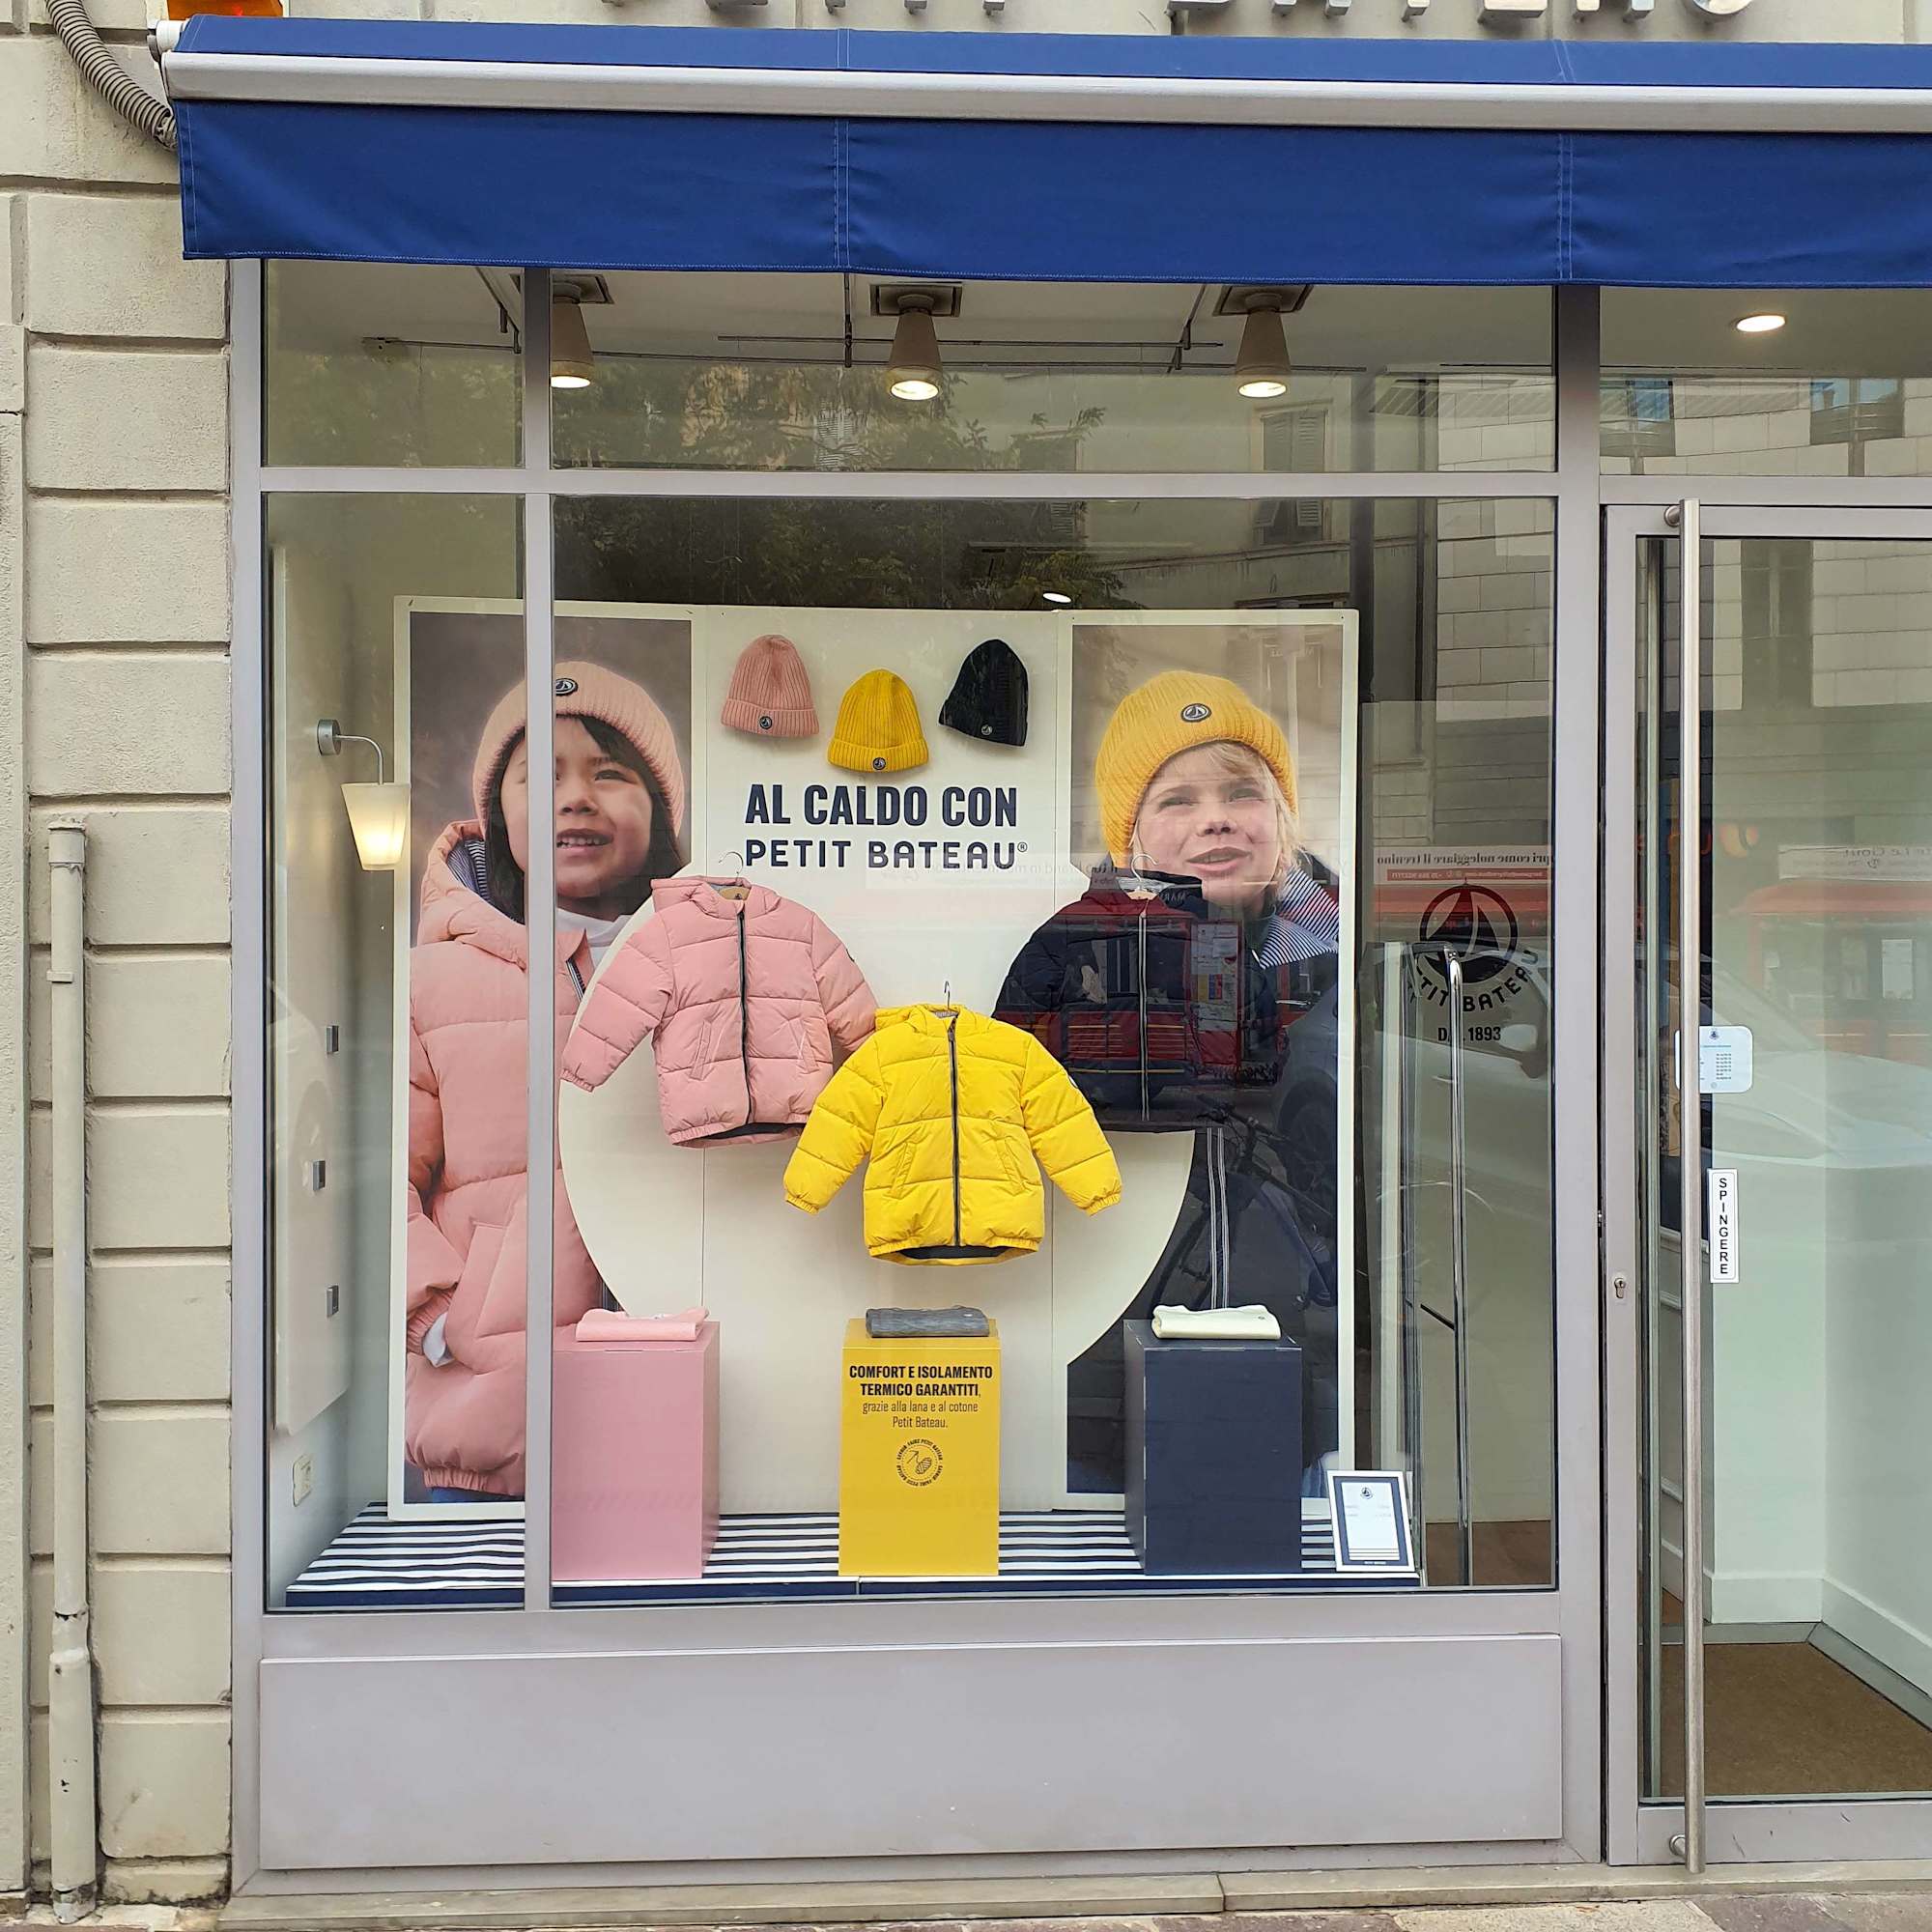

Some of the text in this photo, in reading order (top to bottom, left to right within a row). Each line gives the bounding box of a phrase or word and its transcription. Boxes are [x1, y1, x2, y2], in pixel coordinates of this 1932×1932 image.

[745, 783, 1017, 827] AL CALDO CON
[745, 839, 852, 867] PETIT
[1463, 950, 1539, 1012] BATEAU
[1468, 1026, 1501, 1041] 1893
[1719, 1178, 1729, 1274] SPINGERE
[849, 1365, 993, 1378] COMFORT E ISOLAMENTO
[860, 1383, 913, 1396] TERMICO
[862, 1400, 979, 1414] grazie alla lana e al cotone
[893, 1415, 949, 1428] Petit Bateau.
